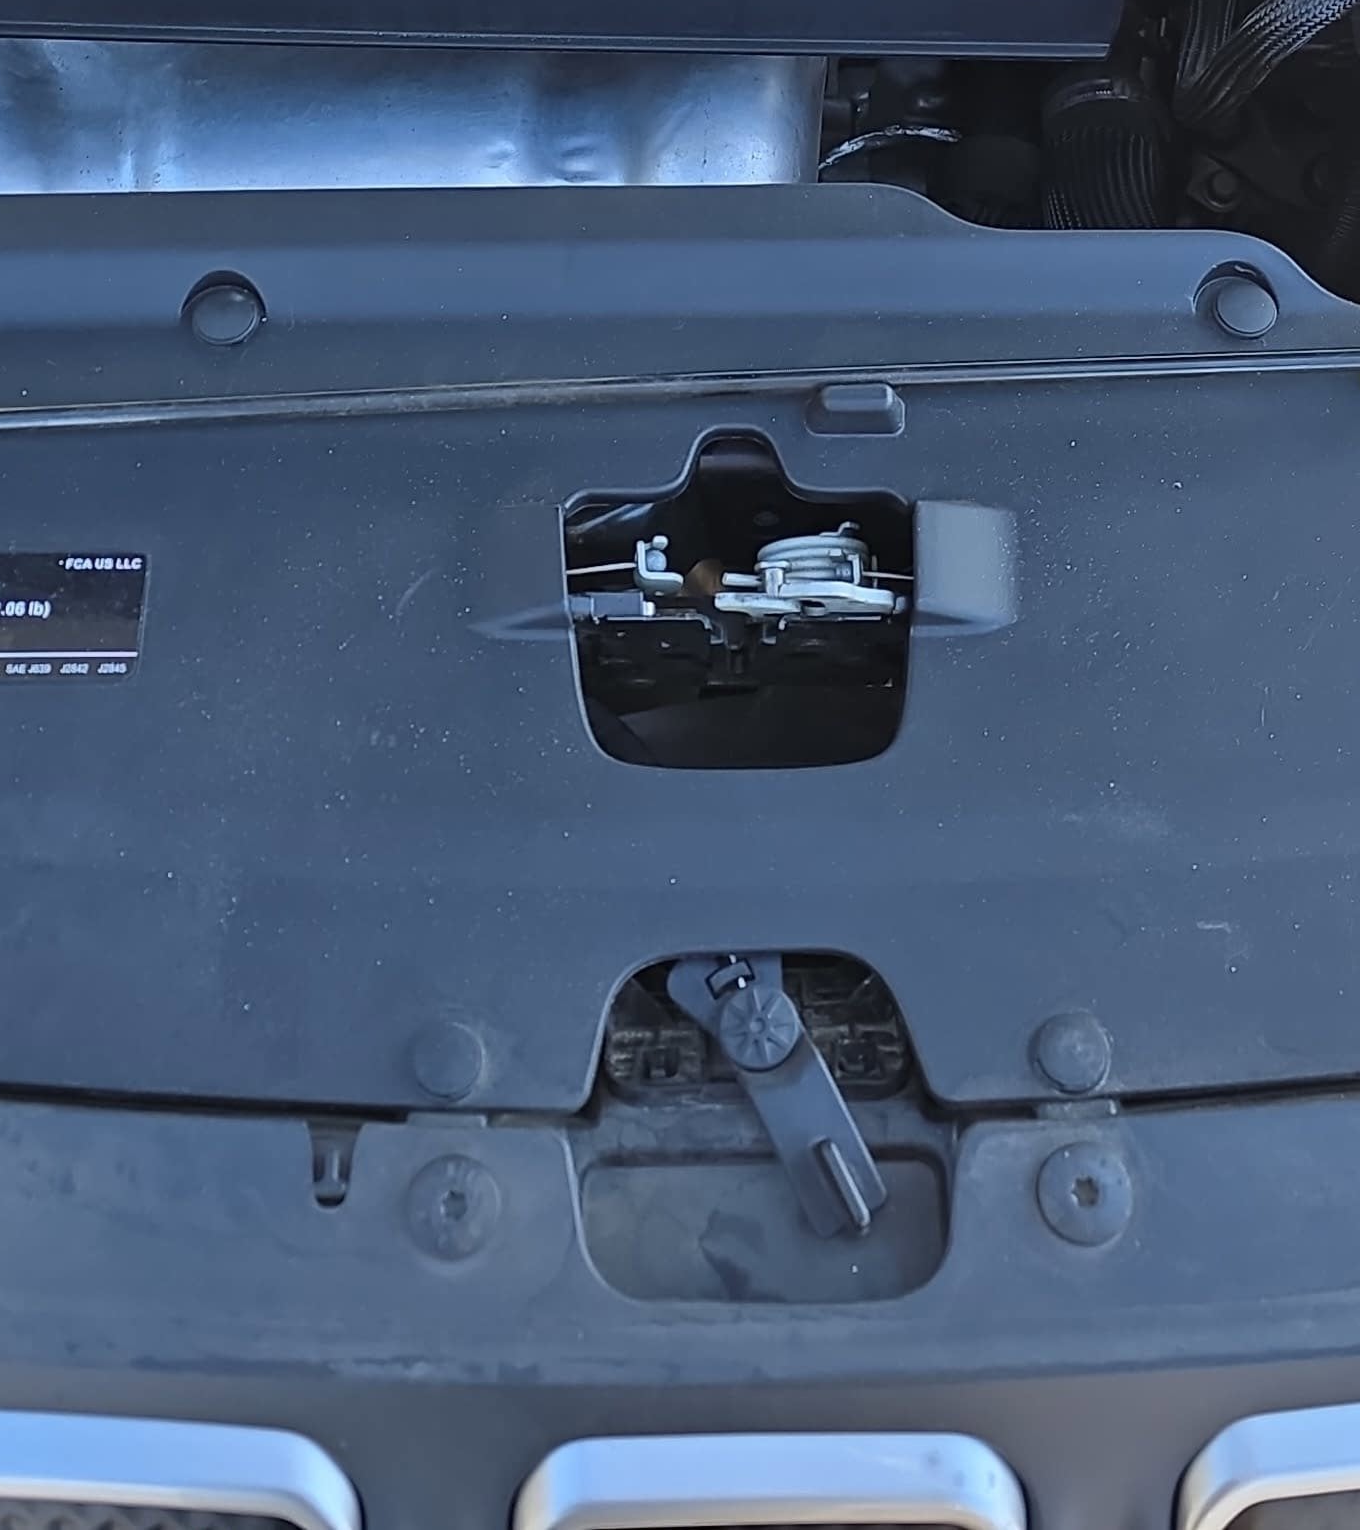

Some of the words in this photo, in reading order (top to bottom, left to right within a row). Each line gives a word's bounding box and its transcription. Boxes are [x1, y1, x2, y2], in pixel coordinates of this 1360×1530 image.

[65, 557, 93, 570] FCA
[94, 557, 114, 570] US
[115, 557, 143, 570] LLC
[27, 600, 52, 619] lb)
